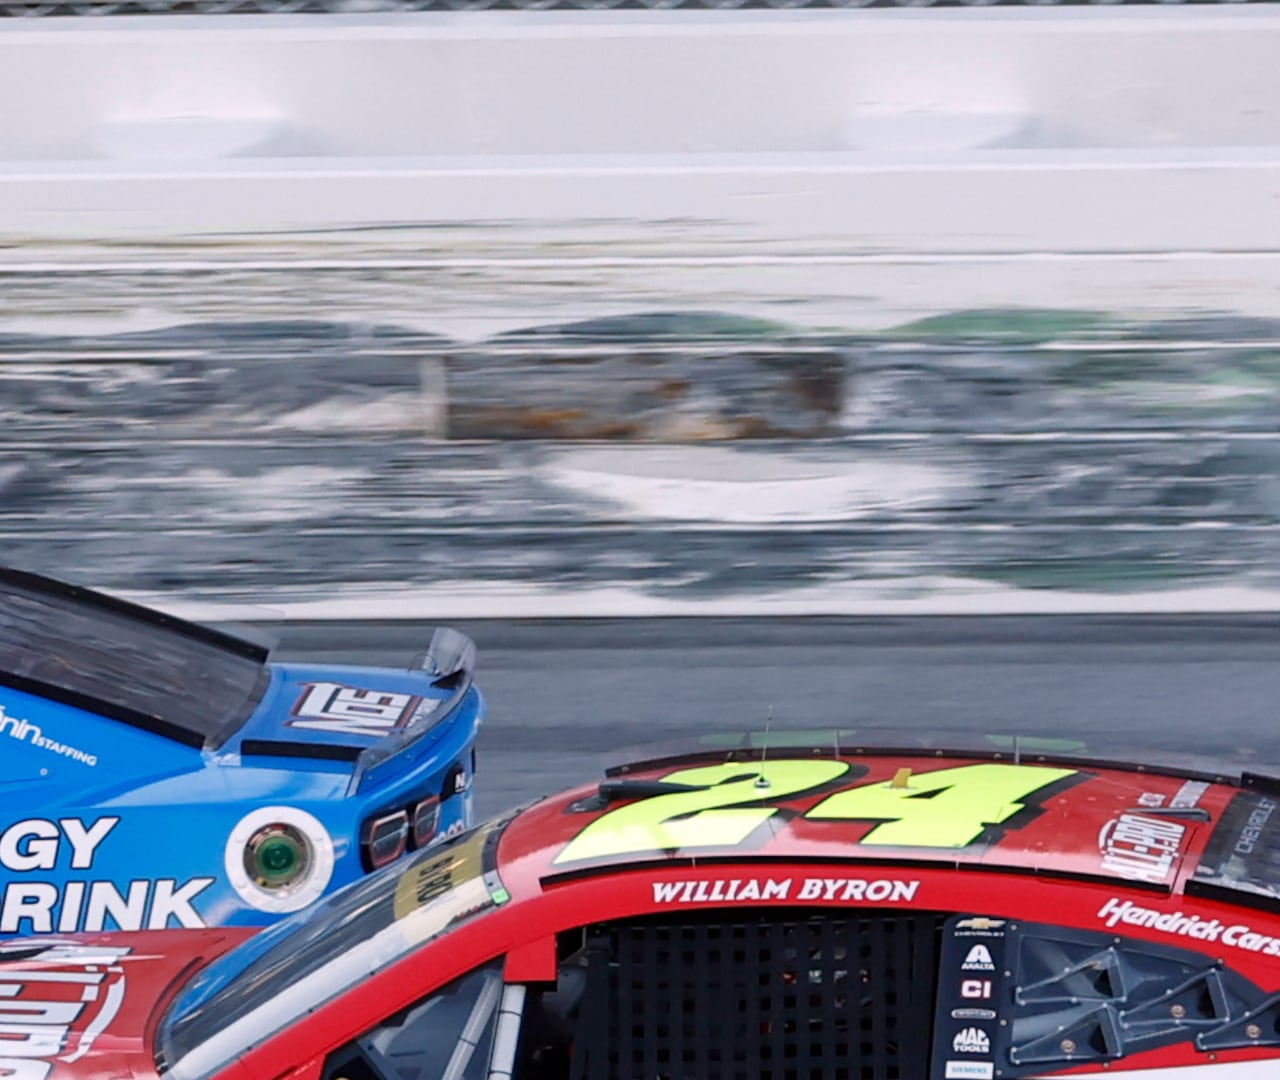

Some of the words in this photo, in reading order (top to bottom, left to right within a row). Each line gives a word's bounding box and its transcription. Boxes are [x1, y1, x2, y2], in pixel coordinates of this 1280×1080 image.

[37, 736, 97, 767] STAFFING
[552, 759, 1080, 867] 24
[1100, 814, 1186, 882] ALL-PRO
[652, 879, 792, 903] WILLIAM
[796, 879, 921, 901] BYRON
